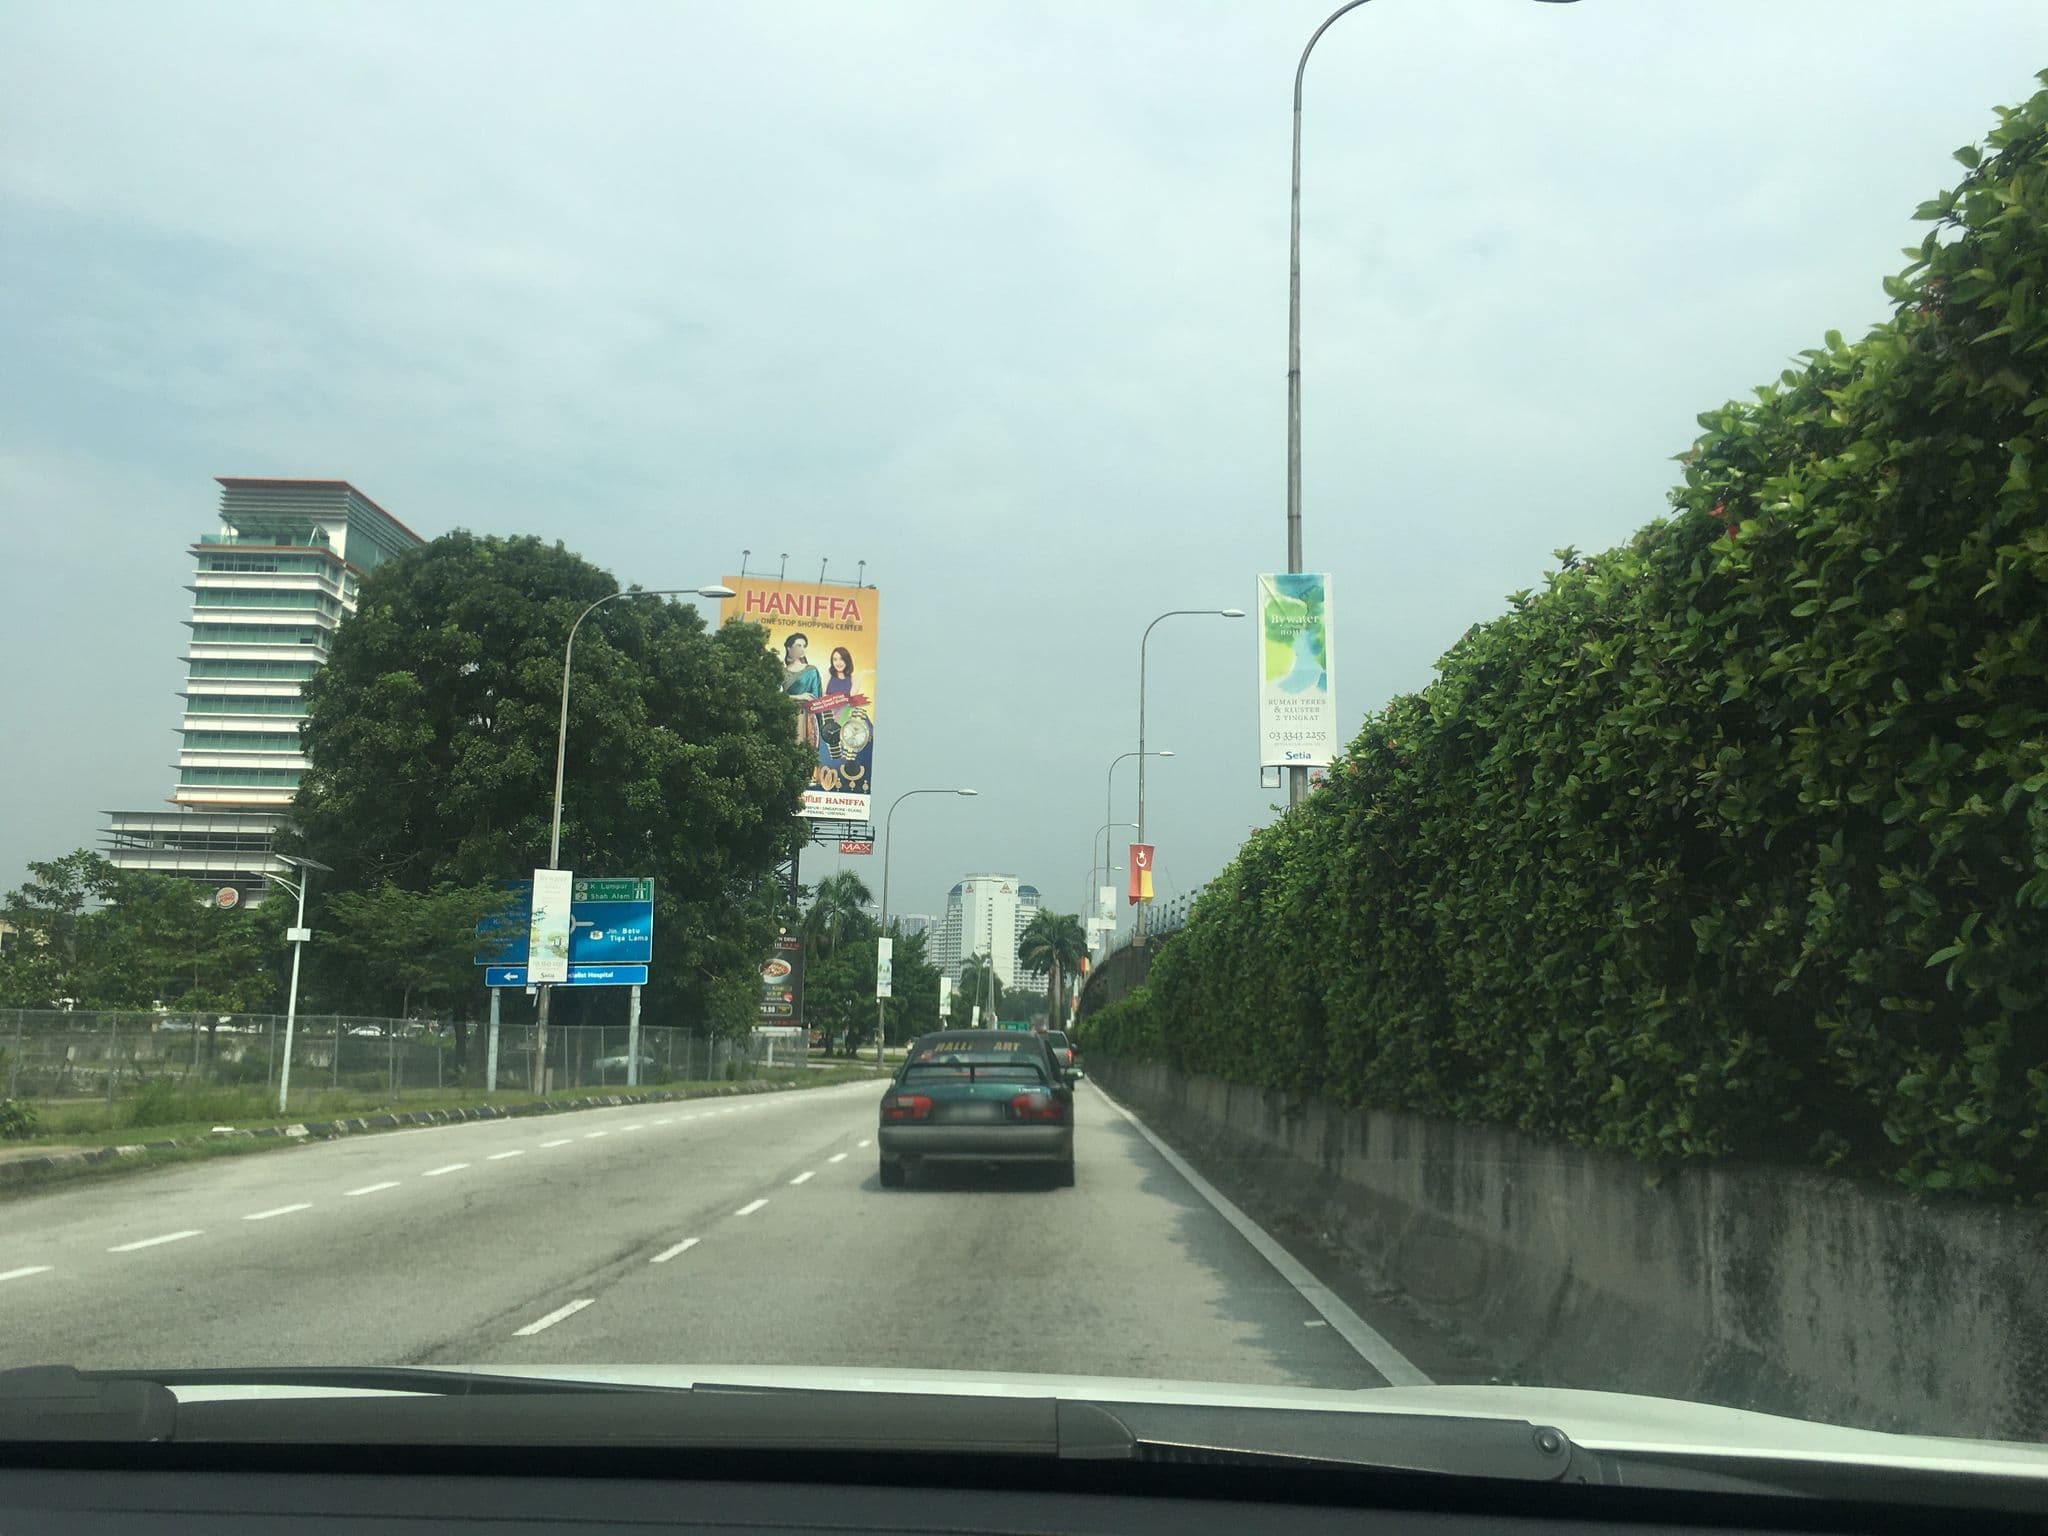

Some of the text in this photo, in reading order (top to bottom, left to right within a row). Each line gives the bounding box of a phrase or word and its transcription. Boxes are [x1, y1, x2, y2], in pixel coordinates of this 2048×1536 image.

[746, 590, 860, 620] HANIFFA
[760, 617, 863, 632] ONE STOP SHOPPING CENTER
[1271, 615, 1319, 627] Bywater
[1273, 706, 1281, 714] &
[1269, 731, 1326, 741] 03 3343 2255
[1286, 751, 1311, 761] Setia
[825, 796, 865, 807] HANIFFA
[841, 843, 871, 852] MAX
[588, 971, 614, 979] Hospital
